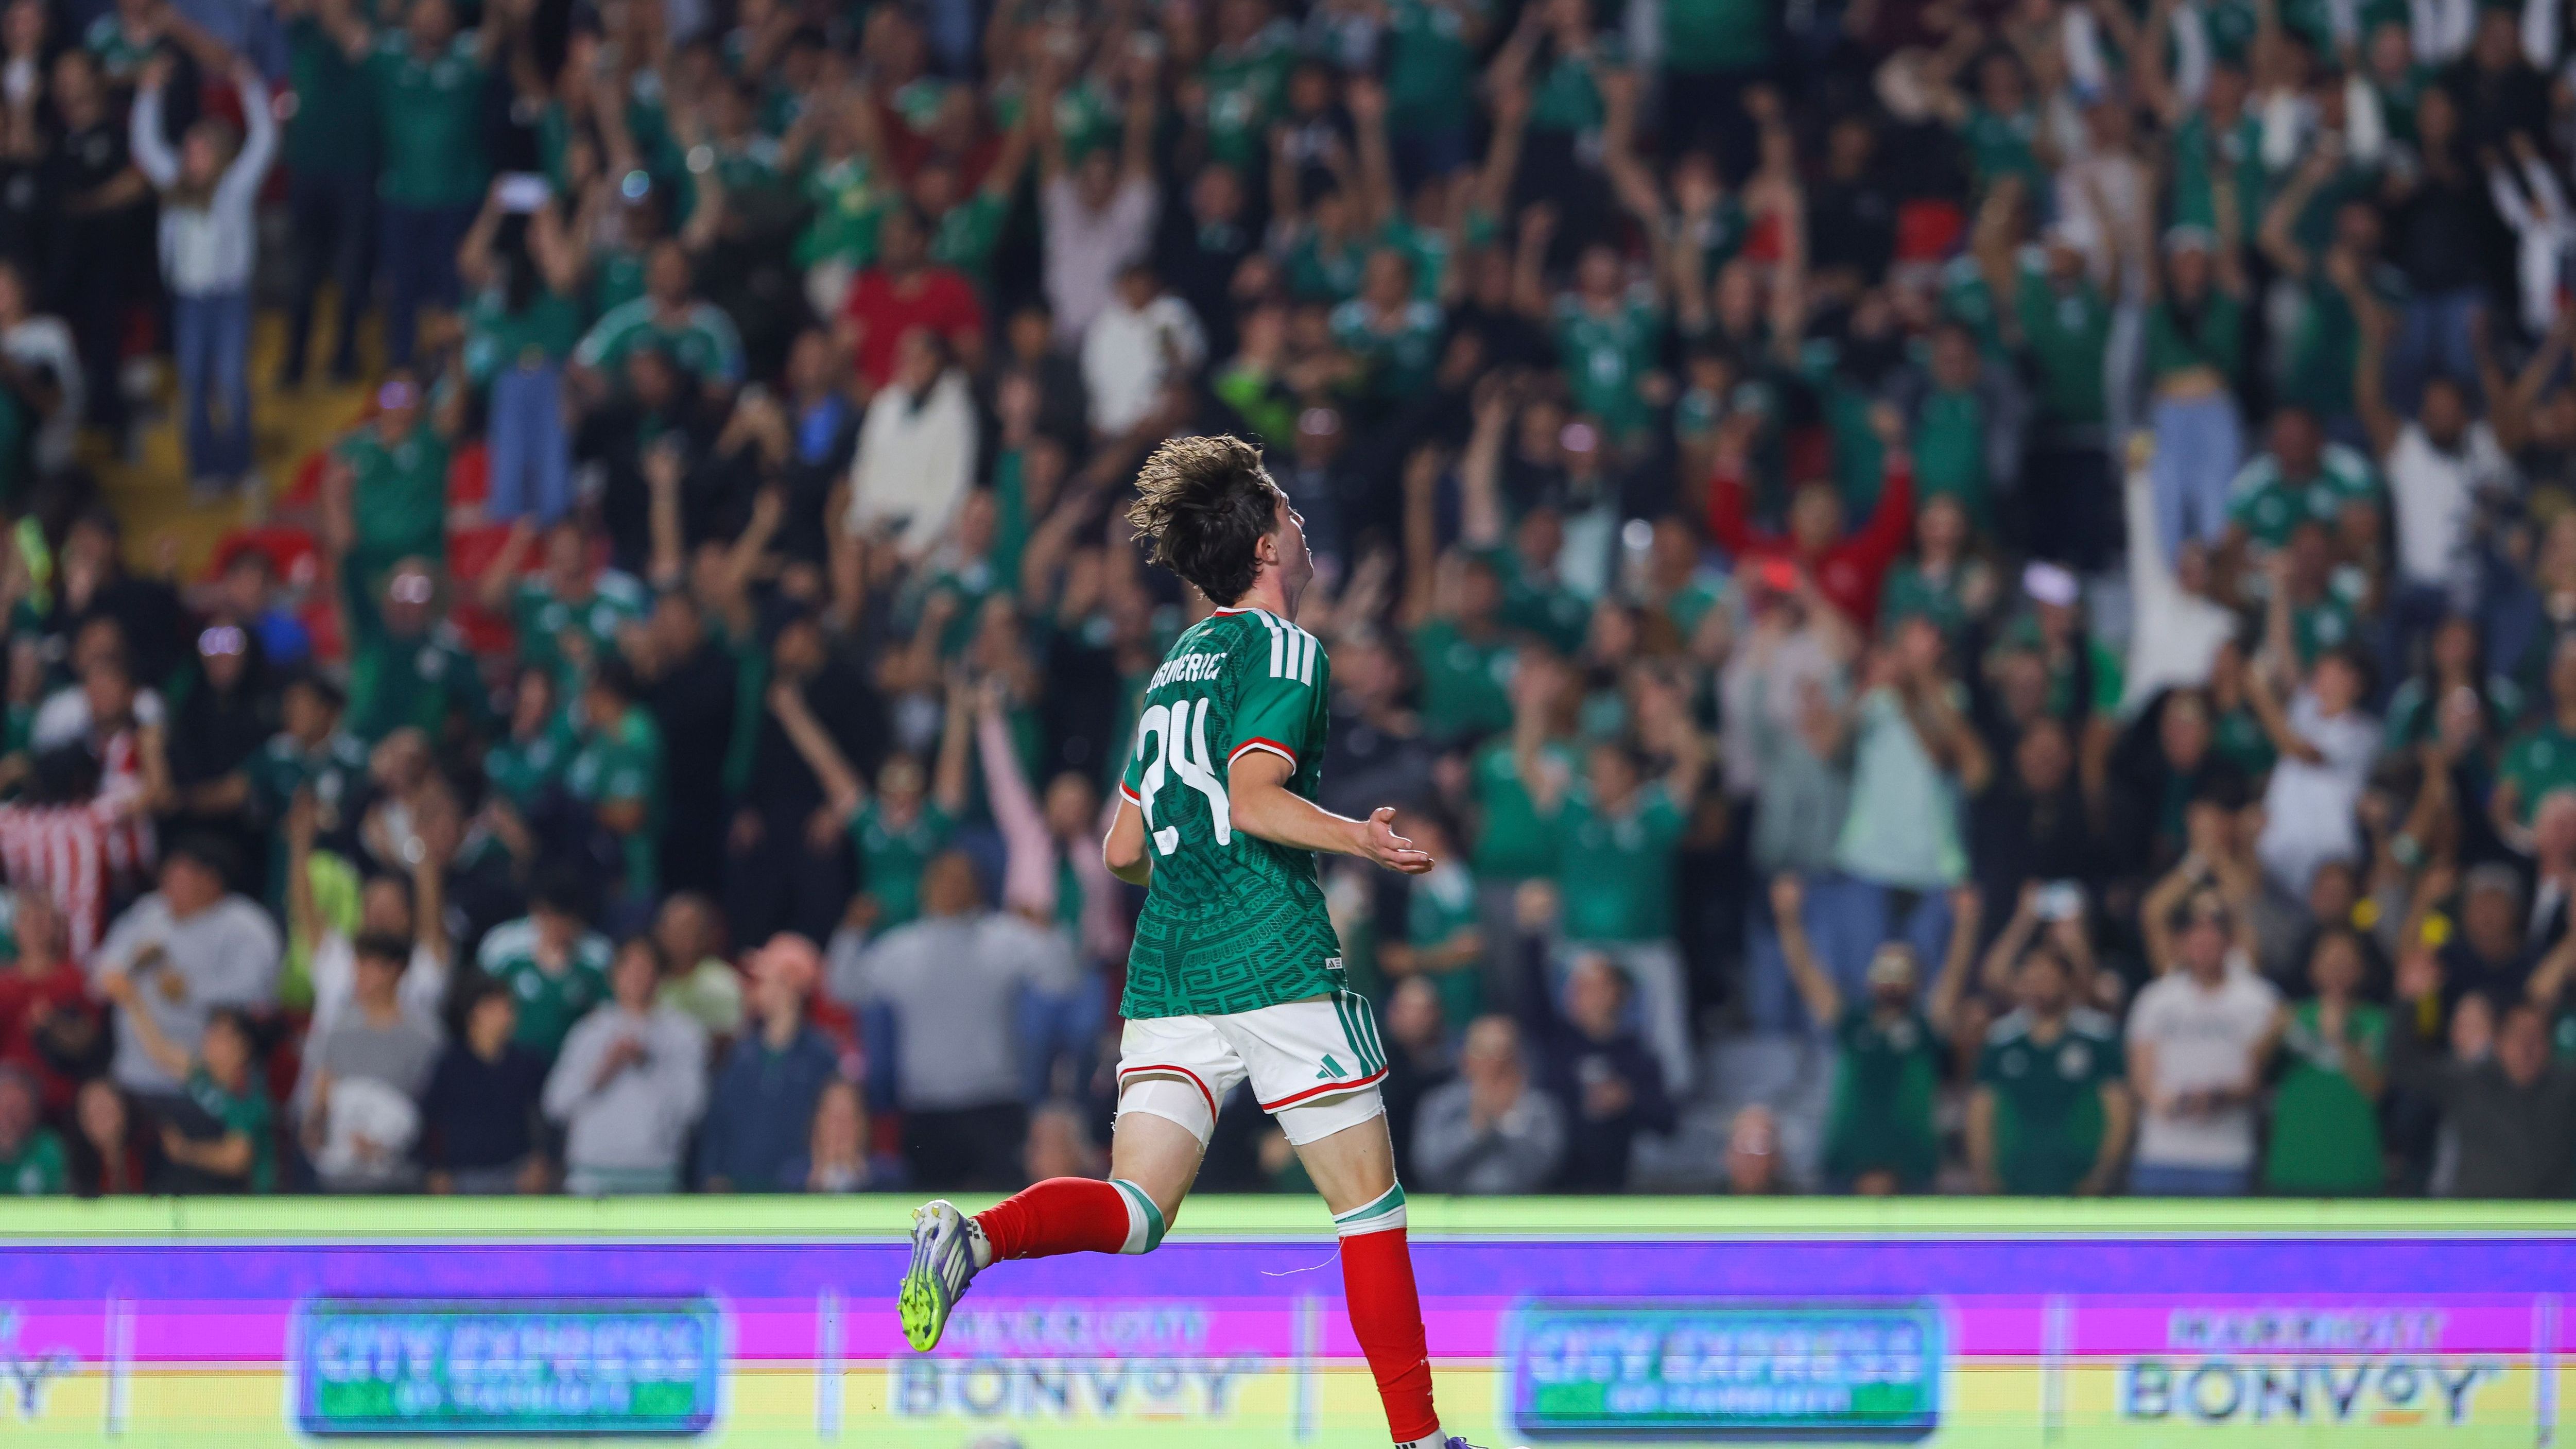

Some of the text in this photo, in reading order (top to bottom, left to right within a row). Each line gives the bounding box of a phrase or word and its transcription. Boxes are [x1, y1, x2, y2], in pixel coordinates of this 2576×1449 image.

[1137, 698, 1231, 856] 24
[895, 1356, 1237, 1419] BONVOY
[2122, 1359, 2488, 1424] BONVOY
